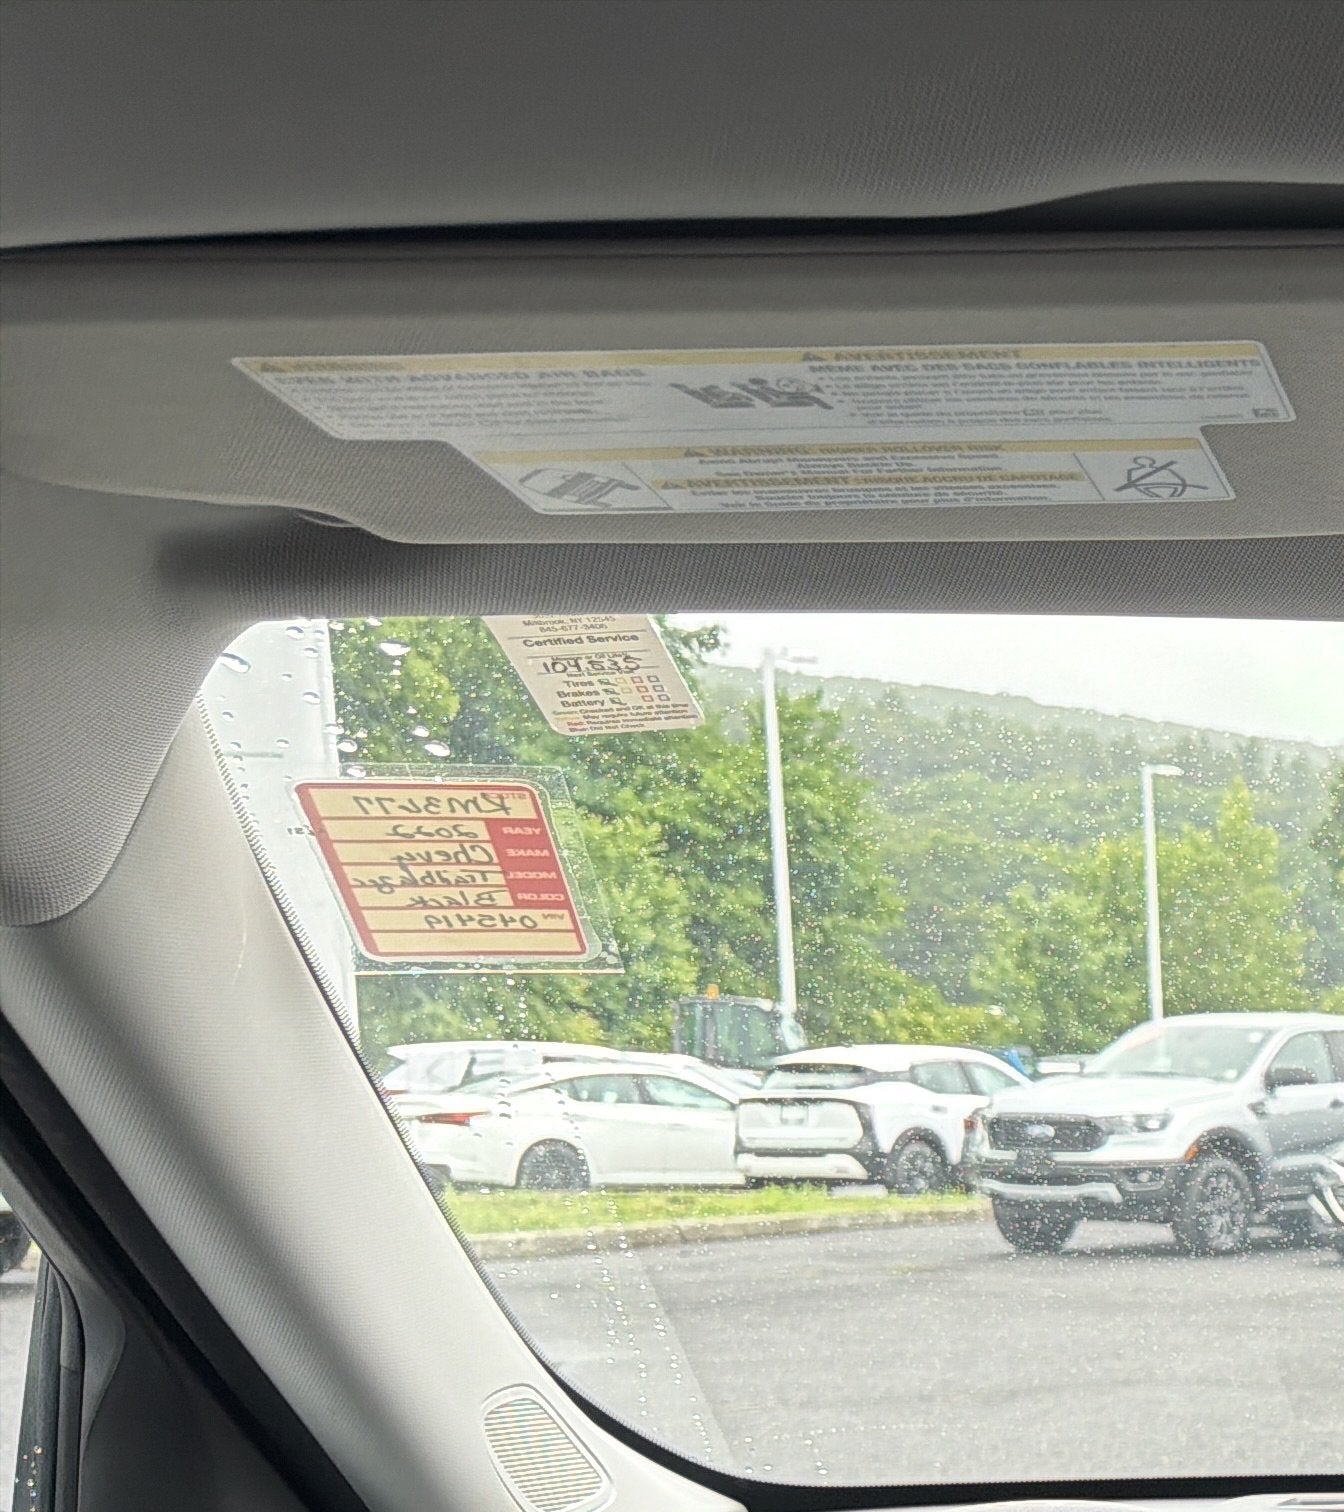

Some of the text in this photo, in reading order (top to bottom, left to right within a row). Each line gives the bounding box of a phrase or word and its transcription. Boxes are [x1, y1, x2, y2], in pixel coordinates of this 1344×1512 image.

[523, 634, 640, 648] Certified Service
[562, 680, 595, 688] Tires
[556, 689, 600, 698] Brakes
[560, 699, 605, 708] Battery
